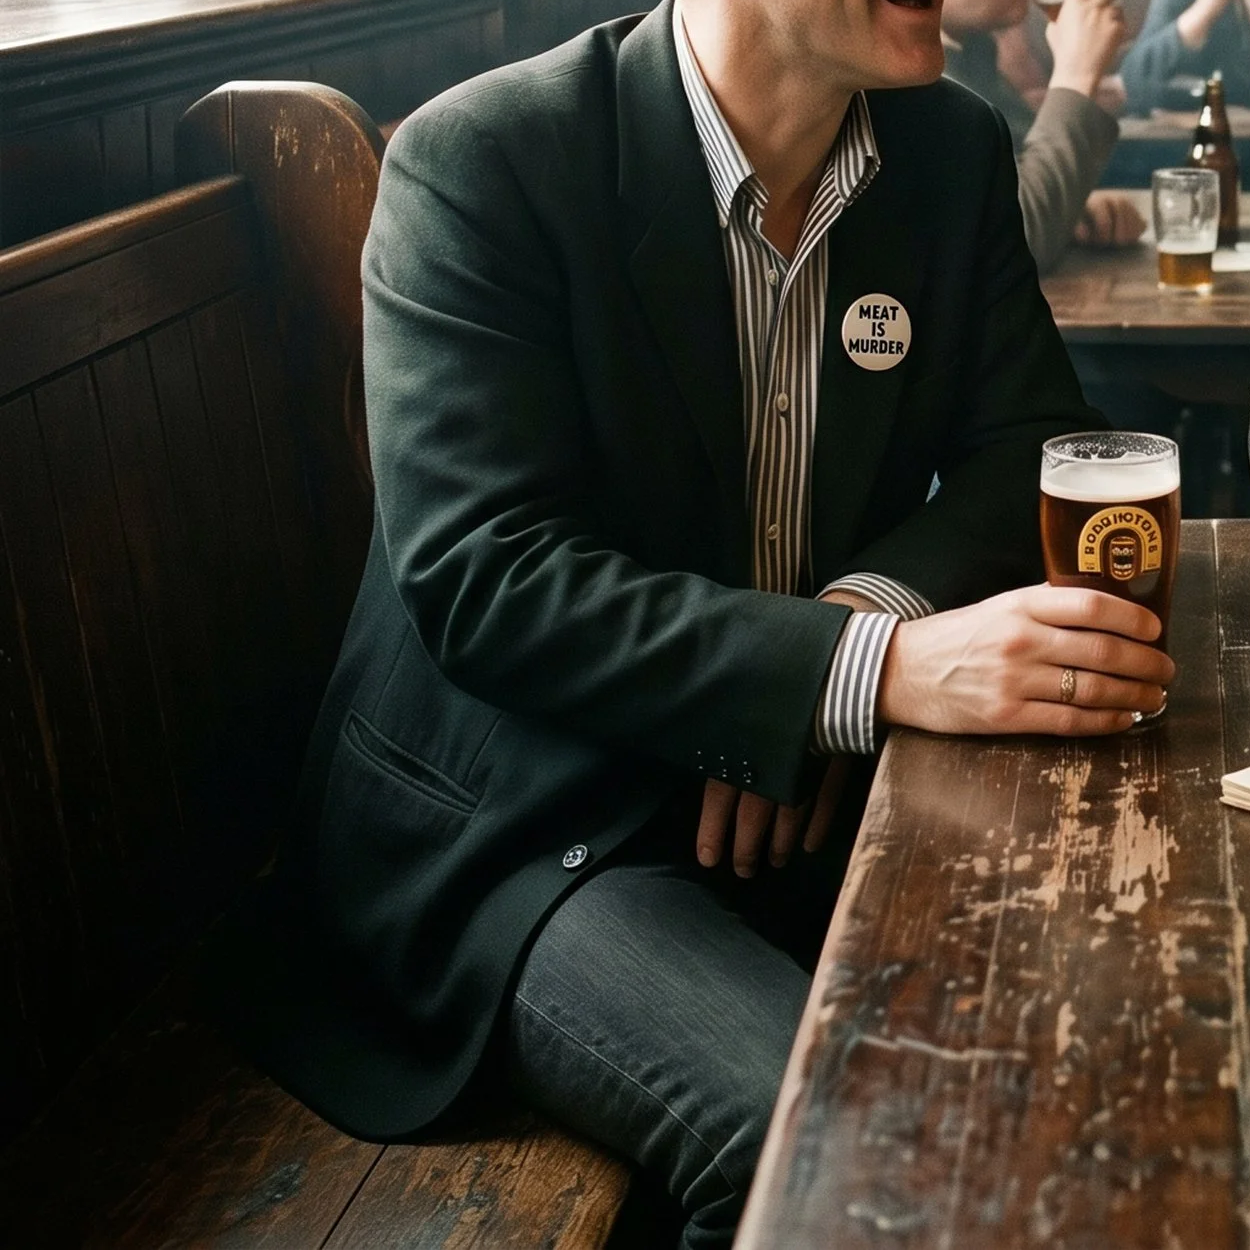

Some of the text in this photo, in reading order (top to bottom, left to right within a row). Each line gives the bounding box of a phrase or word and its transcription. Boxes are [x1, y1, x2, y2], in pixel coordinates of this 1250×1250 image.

[859, 305, 899, 321] MEAT
[872, 322, 885, 337] IS
[849, 338, 904, 355] MURDER
